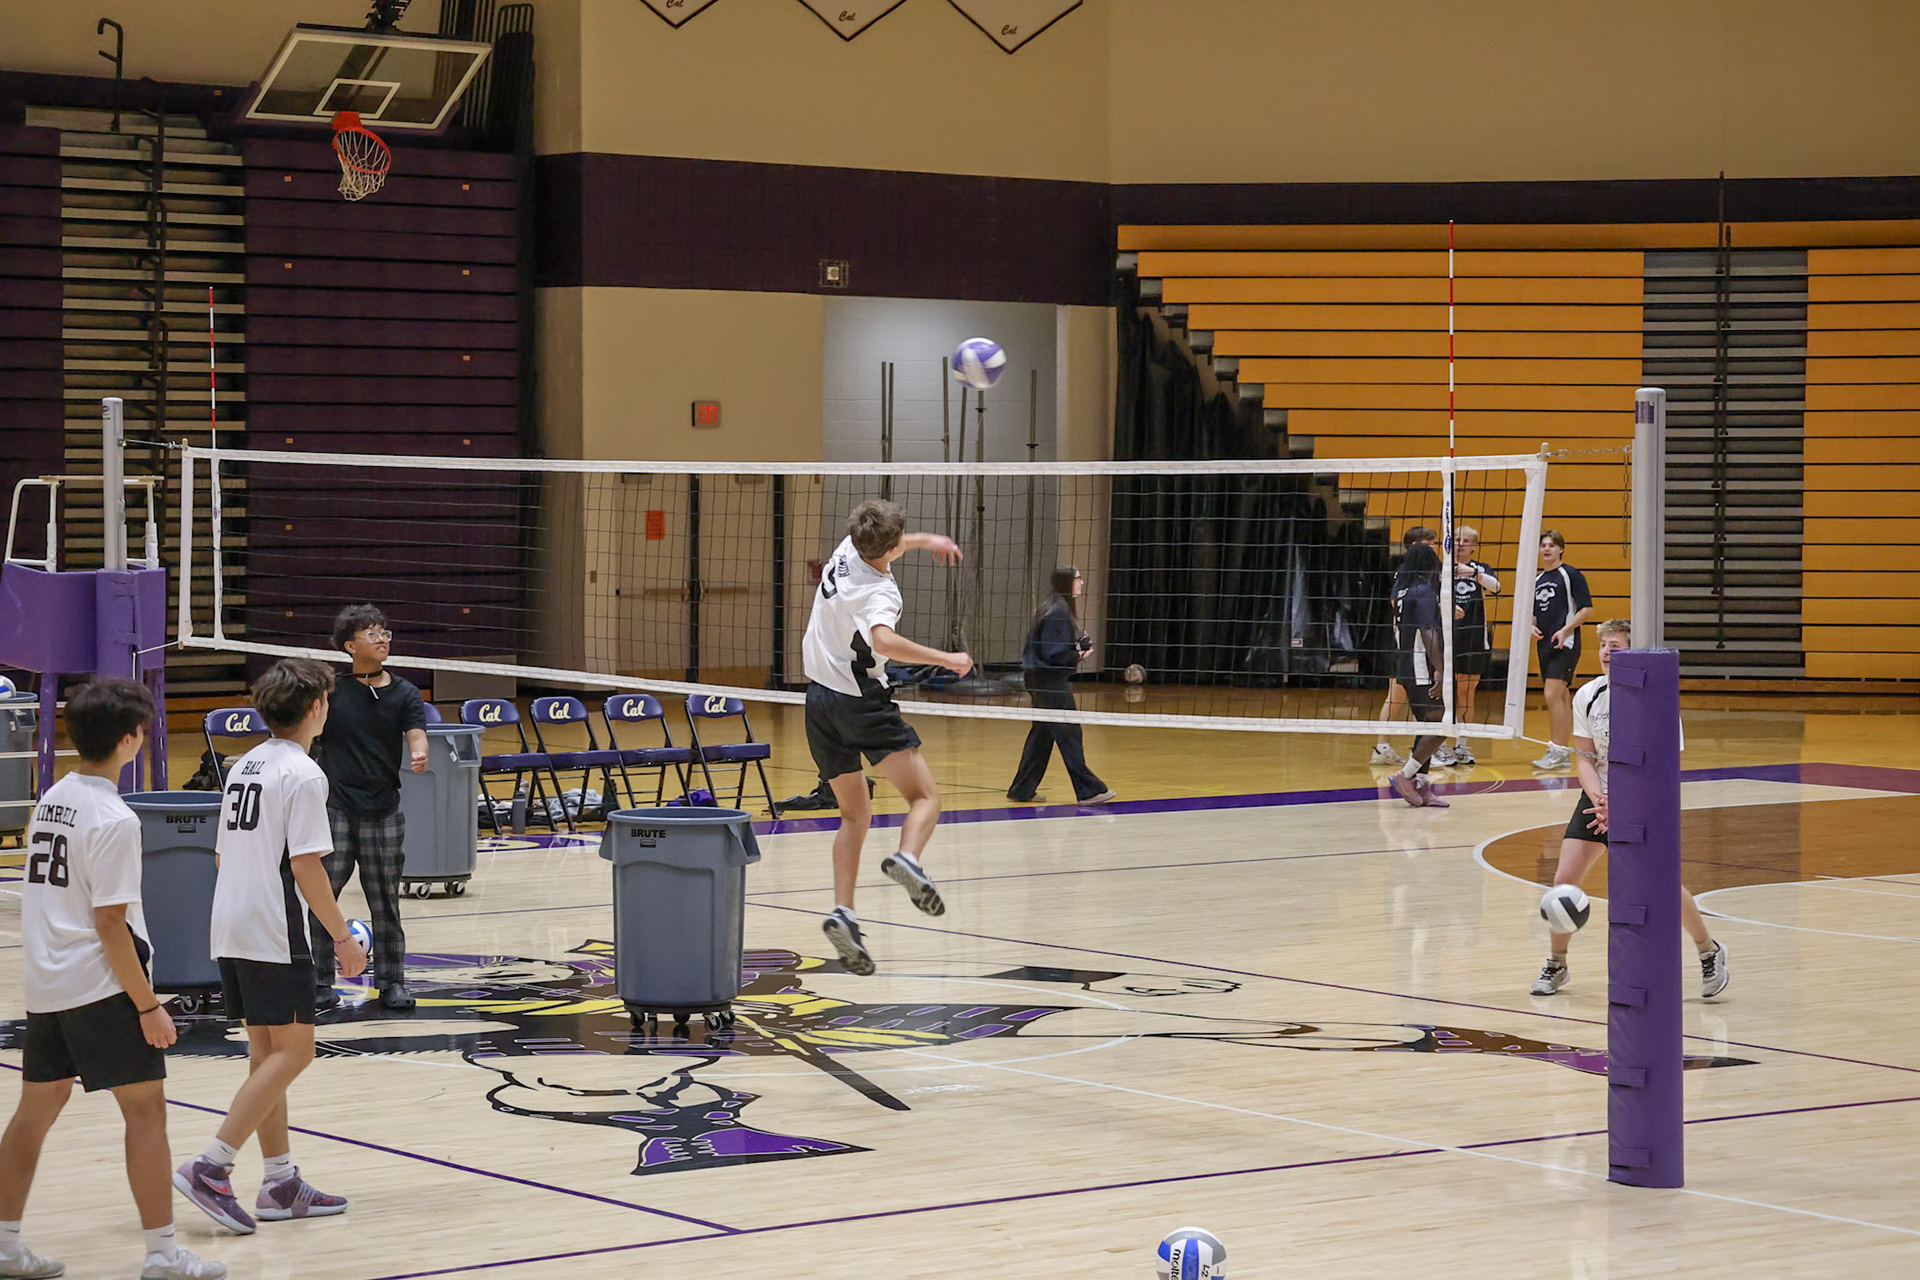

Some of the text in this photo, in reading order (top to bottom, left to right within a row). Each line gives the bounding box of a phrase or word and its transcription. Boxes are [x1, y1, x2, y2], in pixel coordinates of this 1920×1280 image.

[838, 10, 856, 22] Cal
[1001, 24, 1018, 35] Cal
[479, 704, 502, 722] Cal
[548, 701, 571, 720] Cal
[622, 699, 646, 717] Cal
[704, 695, 727, 713] Cal
[225, 713, 251, 732] Cal
[241, 761, 265, 775] HALL
[227, 782, 263, 831] 30
[166, 814, 207, 824] BRUTE
[630, 828, 666, 838] BRUTE
[28, 831, 69, 888] 28
